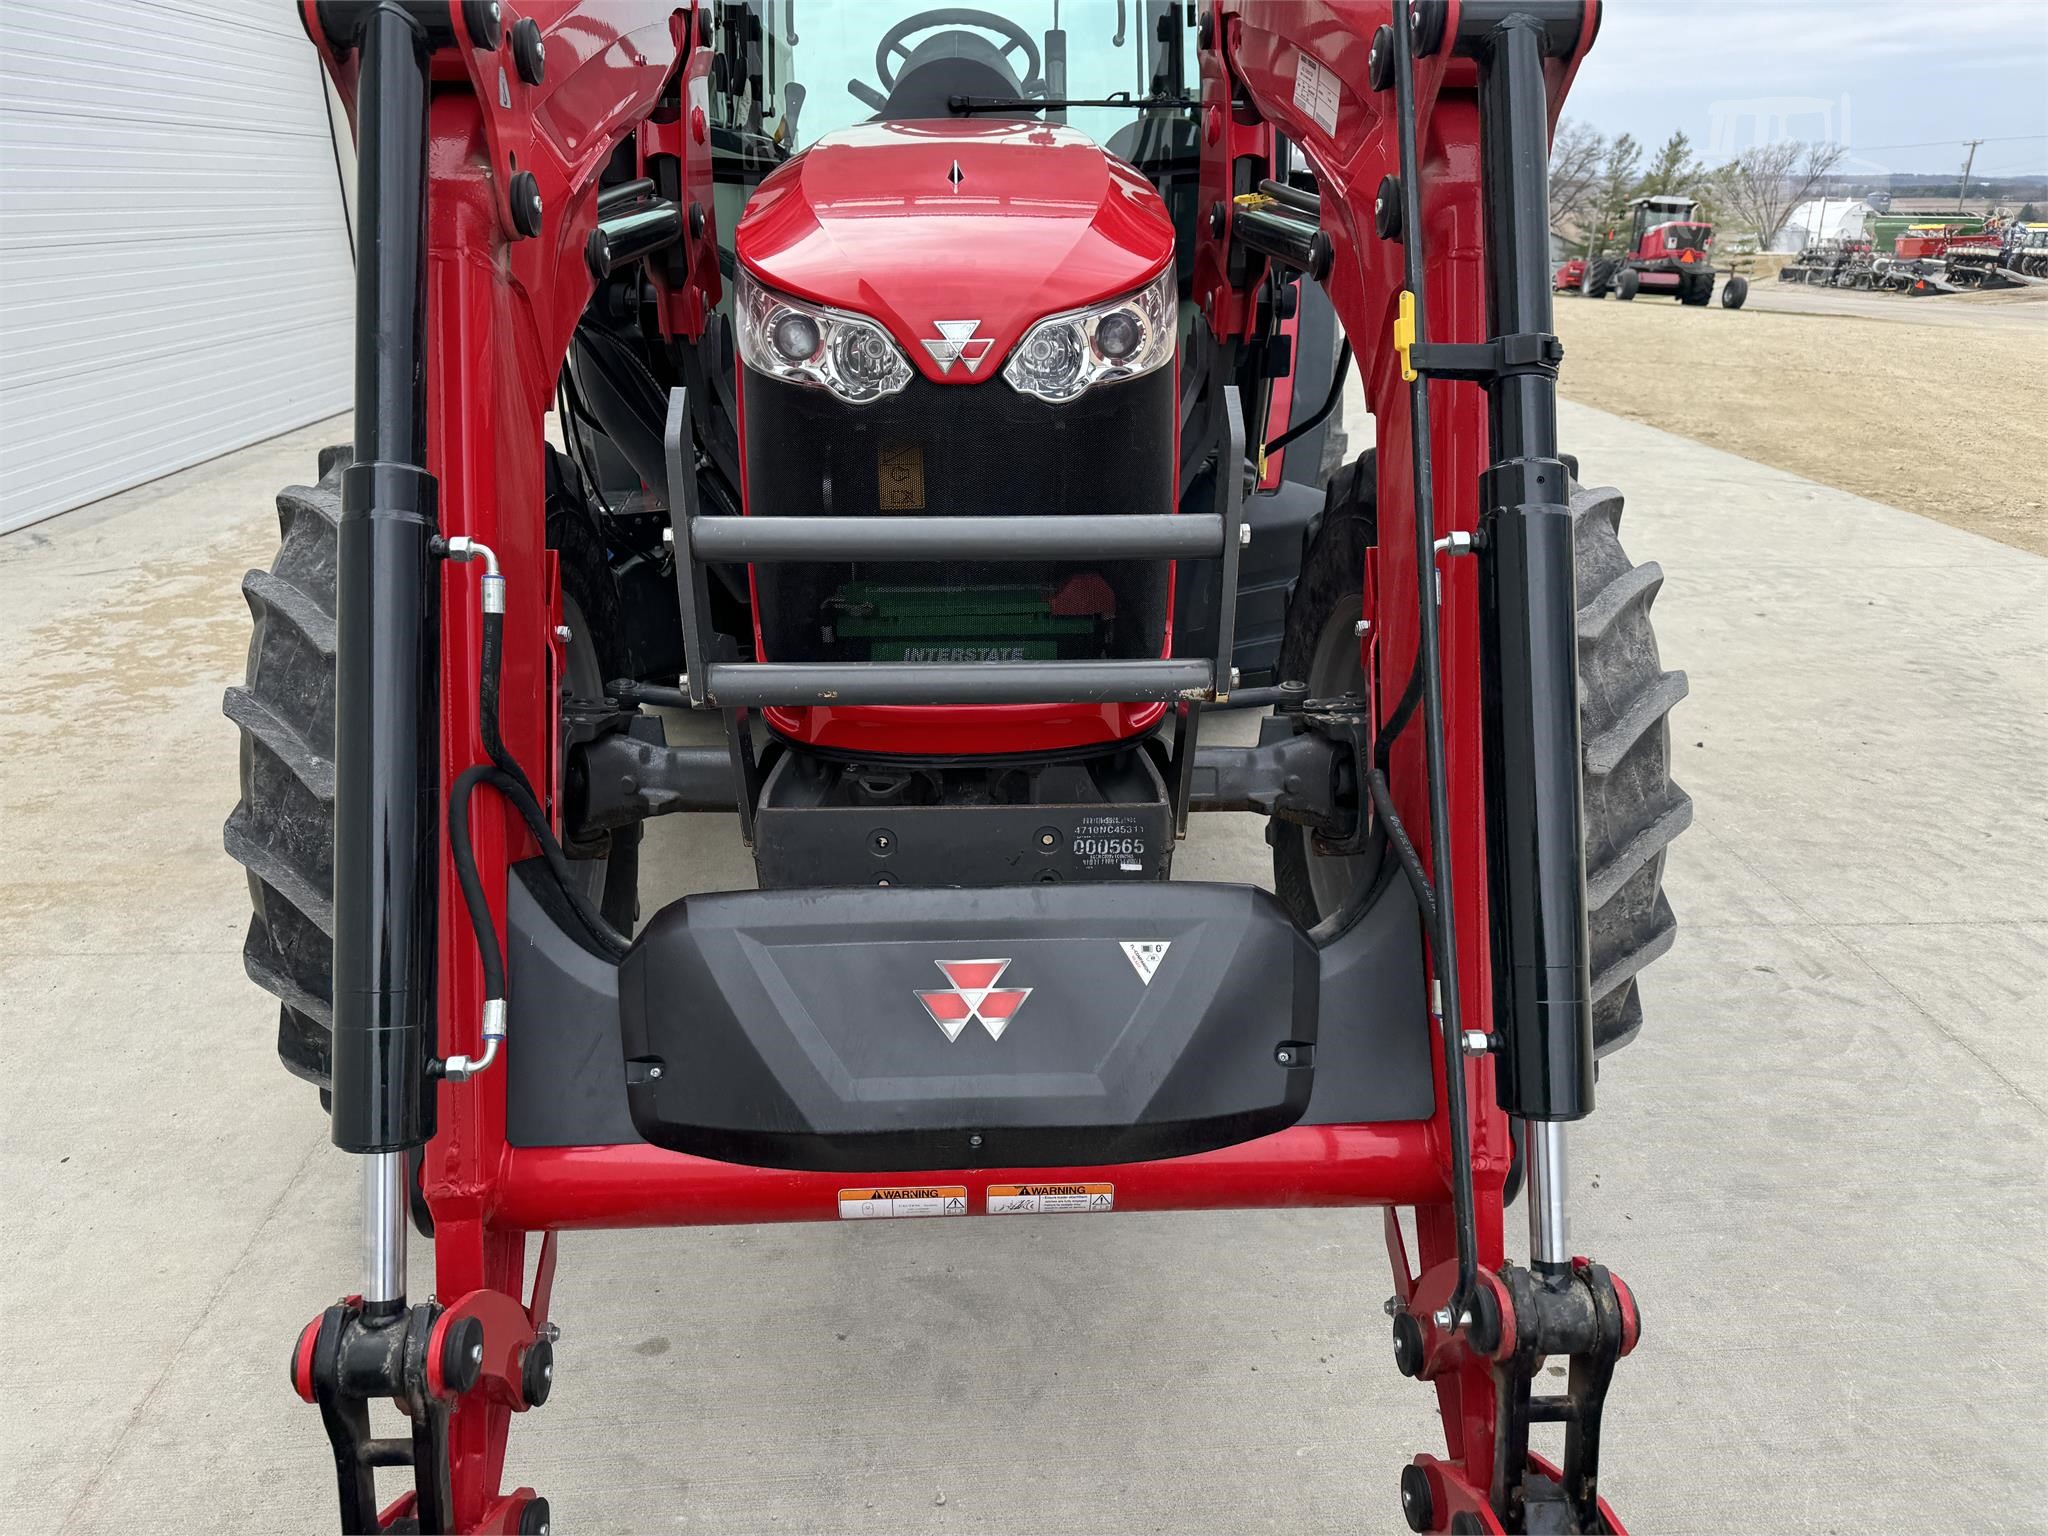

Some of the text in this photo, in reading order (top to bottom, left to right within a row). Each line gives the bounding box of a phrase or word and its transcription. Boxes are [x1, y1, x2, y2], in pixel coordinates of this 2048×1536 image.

[903, 647, 1025, 662] INTERSTATE
[1073, 838, 1145, 855] 000565
[883, 1189, 939, 1199] WARNING
[1031, 1186, 1086, 1195] WARNING
